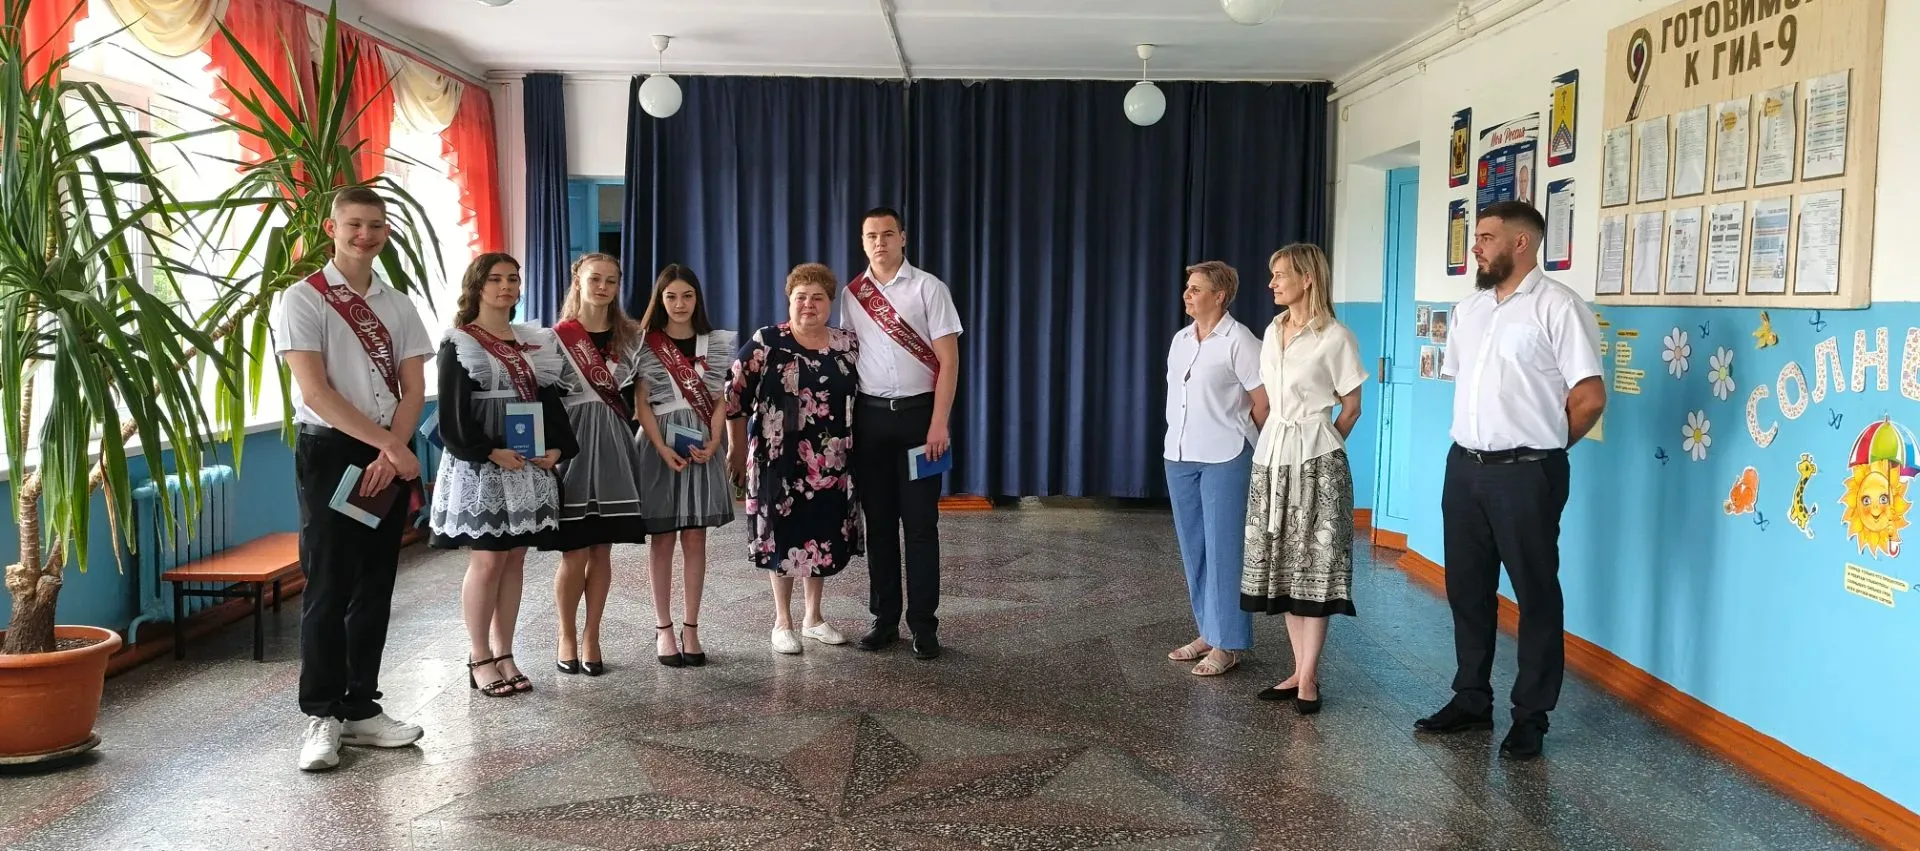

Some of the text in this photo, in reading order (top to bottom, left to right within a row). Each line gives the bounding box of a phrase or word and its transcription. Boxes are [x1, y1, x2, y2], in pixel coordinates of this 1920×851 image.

[1685, 14, 1798, 88] К ГИА-9
[1490, 126, 1526, 147] Моя Россия
